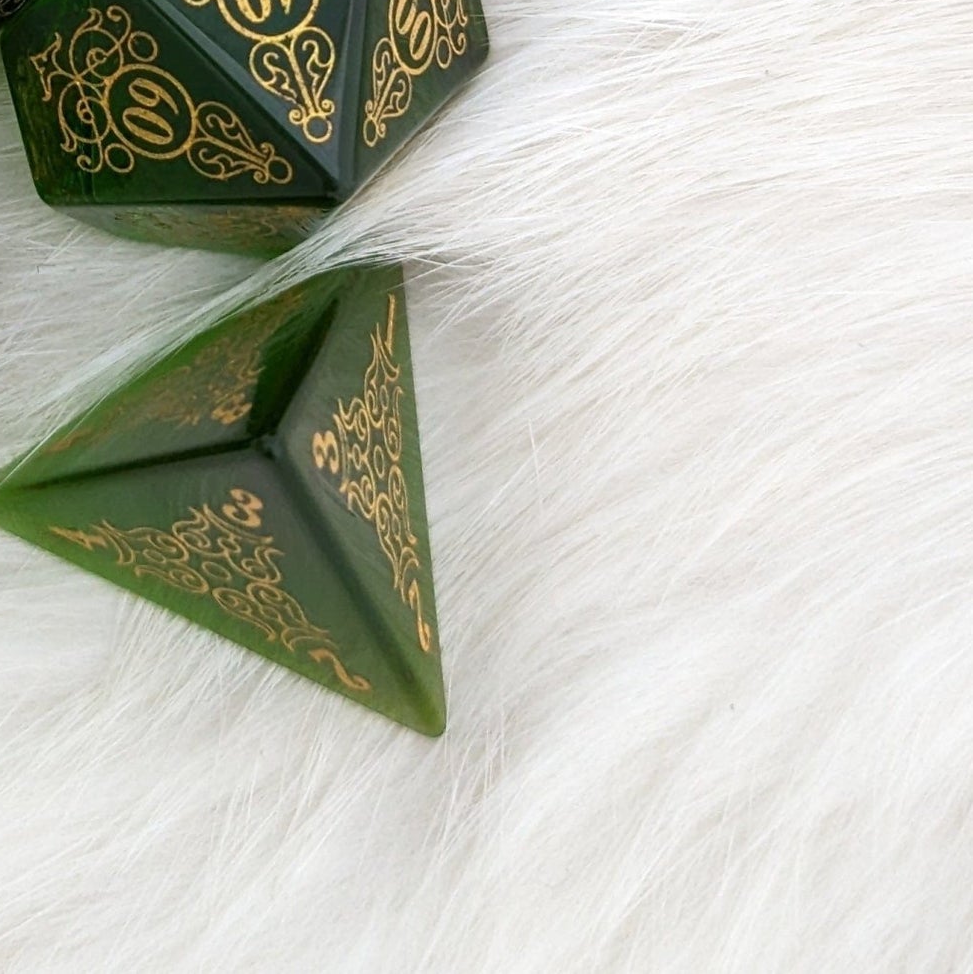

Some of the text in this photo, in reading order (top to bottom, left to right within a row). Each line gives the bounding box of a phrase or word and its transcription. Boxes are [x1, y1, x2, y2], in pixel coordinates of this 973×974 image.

[313, 430, 339, 473] 3
[222, 488, 263, 528] 3
[309, 648, 371, 691] 2
